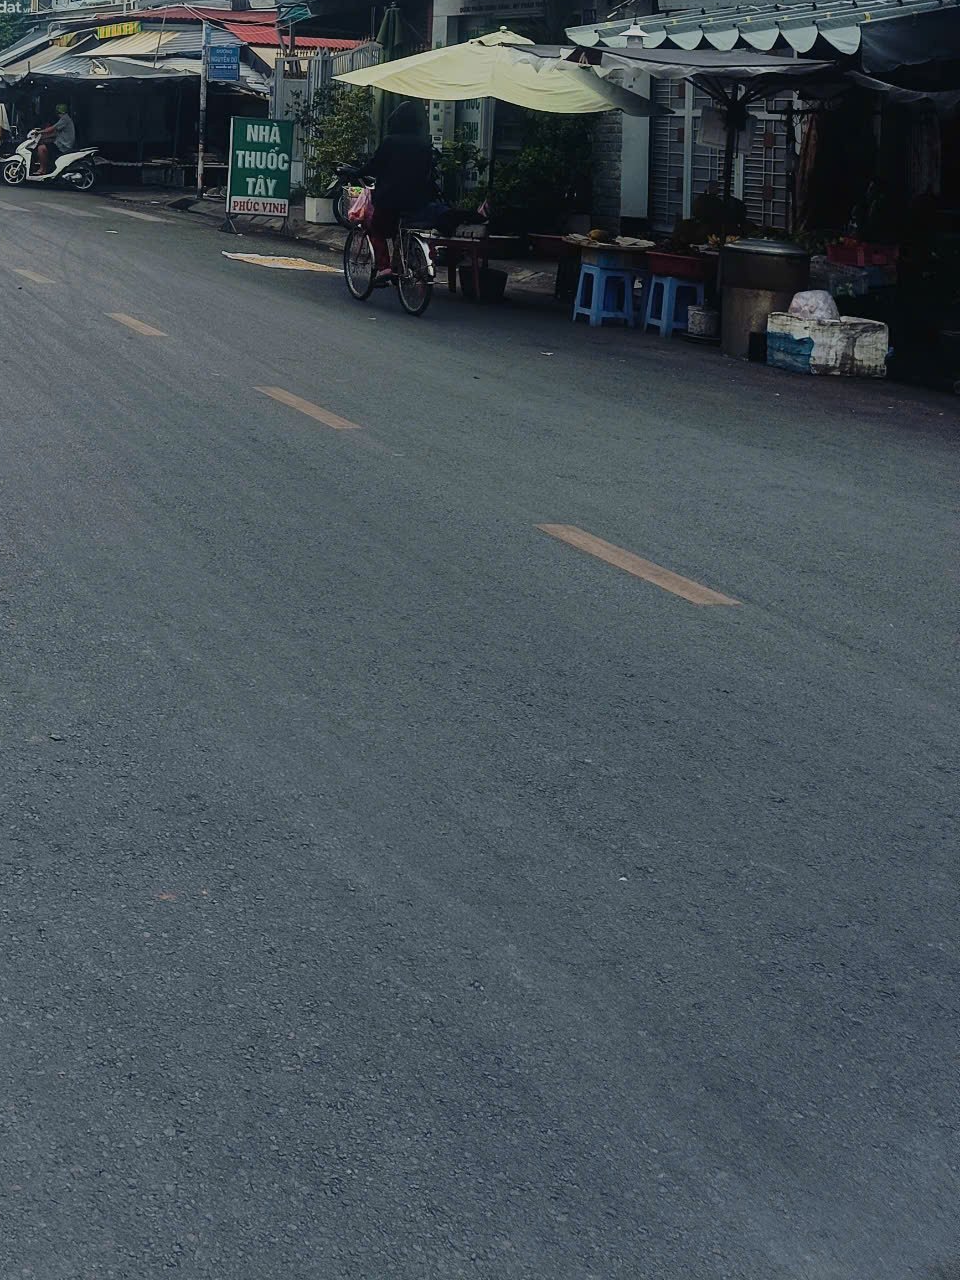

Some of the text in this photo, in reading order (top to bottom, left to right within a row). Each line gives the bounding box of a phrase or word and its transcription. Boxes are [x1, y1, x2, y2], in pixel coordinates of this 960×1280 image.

[246, 122, 281, 144] NHÀ
[236, 146, 289, 171] THUỐC
[246, 175, 277, 196] TÂY
[233, 198, 287, 214] PHÚC VINH
